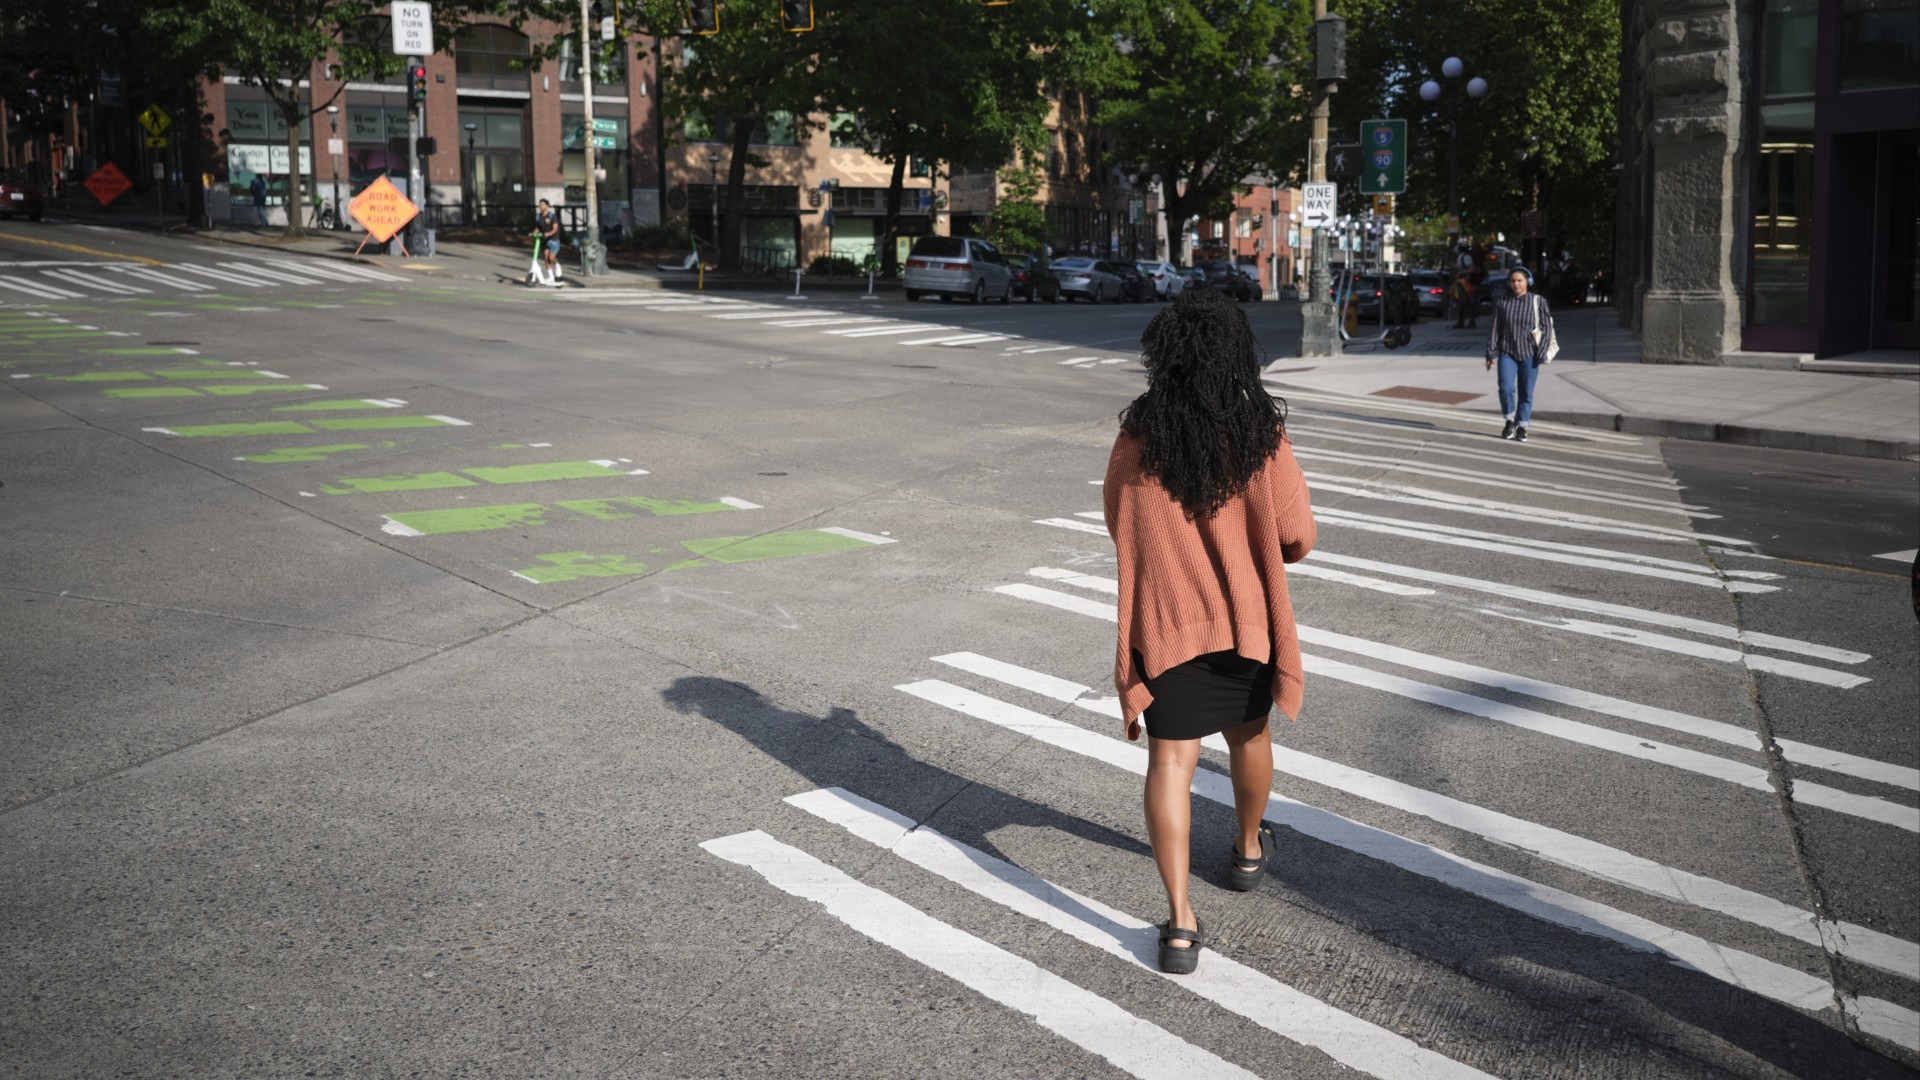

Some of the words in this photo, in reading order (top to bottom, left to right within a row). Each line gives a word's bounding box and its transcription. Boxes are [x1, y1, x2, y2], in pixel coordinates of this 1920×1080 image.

[403, 8, 420, 18] NO
[401, 20, 423, 28] TURN
[406, 30, 418, 38] ON
[405, 40, 422, 49] RED
[1379, 134, 1387, 143] 5
[1376, 156, 1390, 166] 90
[369, 193, 397, 201] ROAD
[1307, 187, 1331, 198] ONE
[369, 204, 397, 213] WORK
[1306, 200, 1331, 210] WAY
[366, 216, 400, 225] AHEAD
